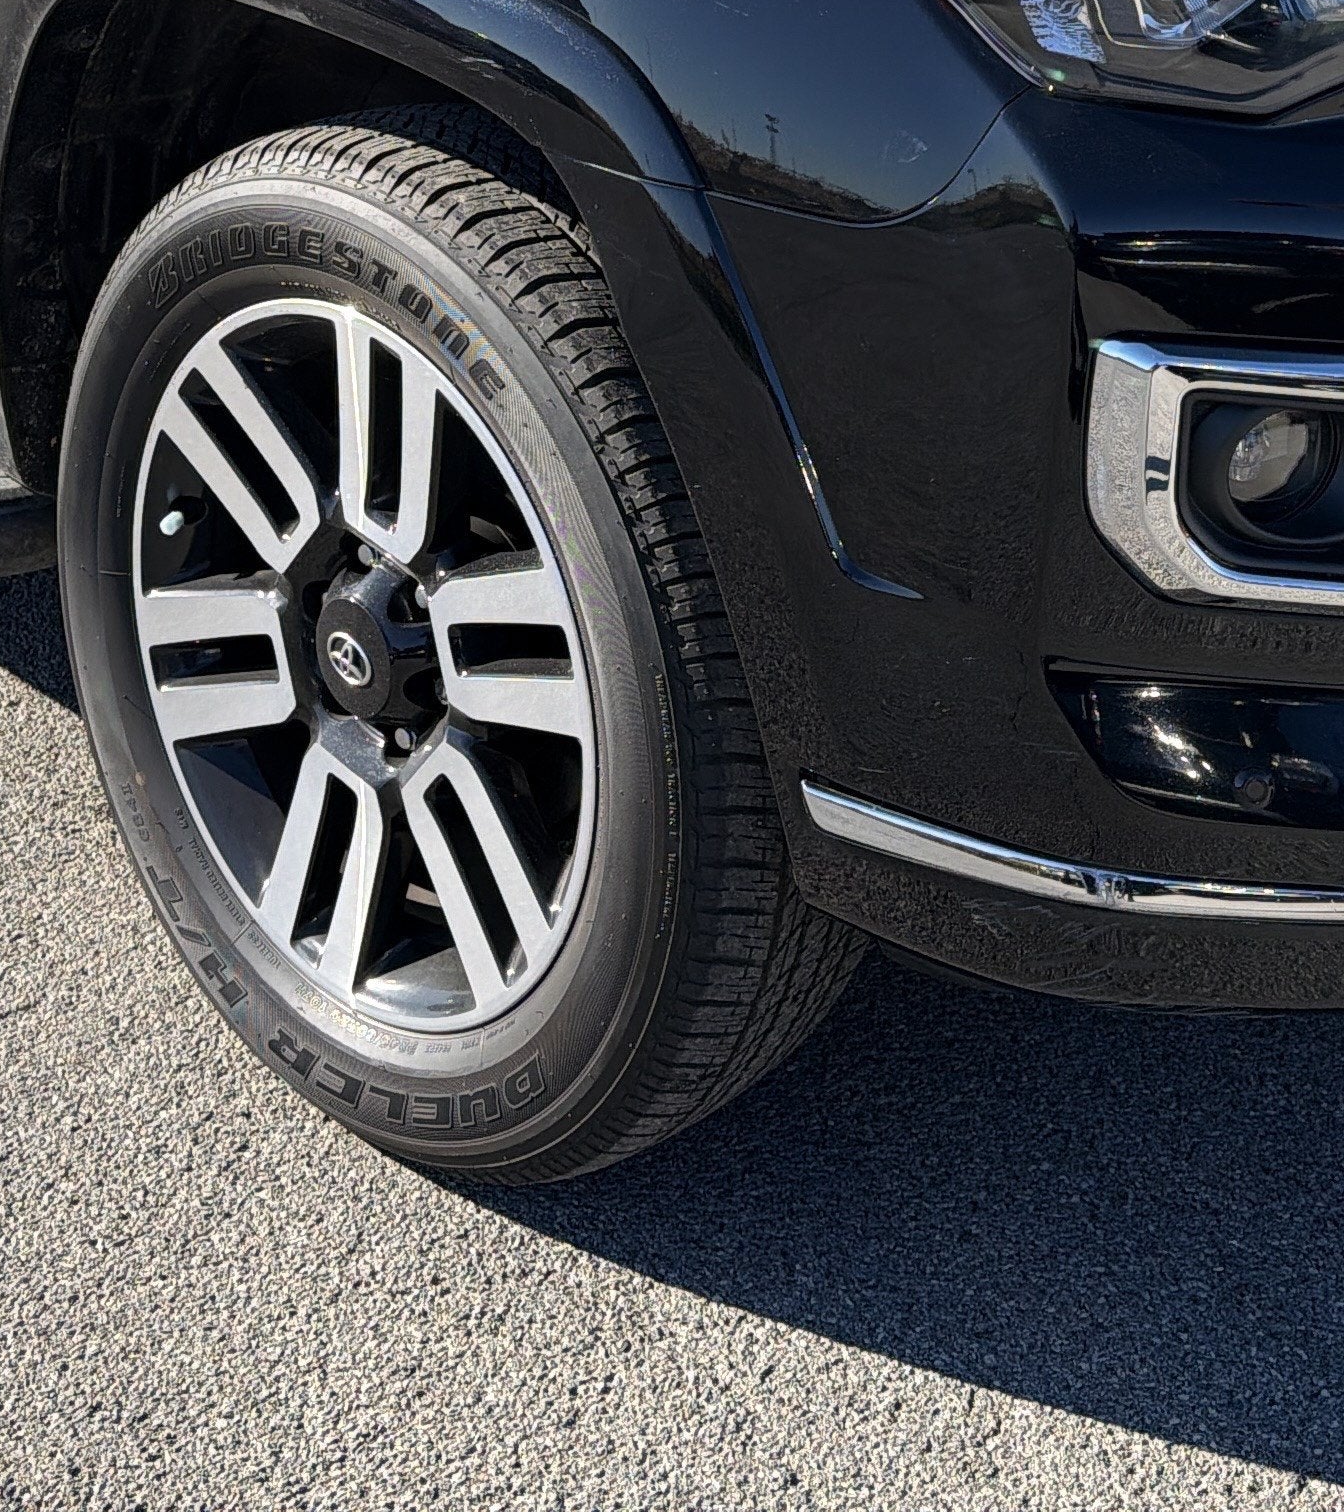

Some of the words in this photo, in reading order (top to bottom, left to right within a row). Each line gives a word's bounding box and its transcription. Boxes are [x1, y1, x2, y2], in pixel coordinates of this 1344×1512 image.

[147, 221, 507, 401] BRIDGESTONE
[146, 864, 249, 1009] H/T
[268, 1027, 548, 1129] DUELER
